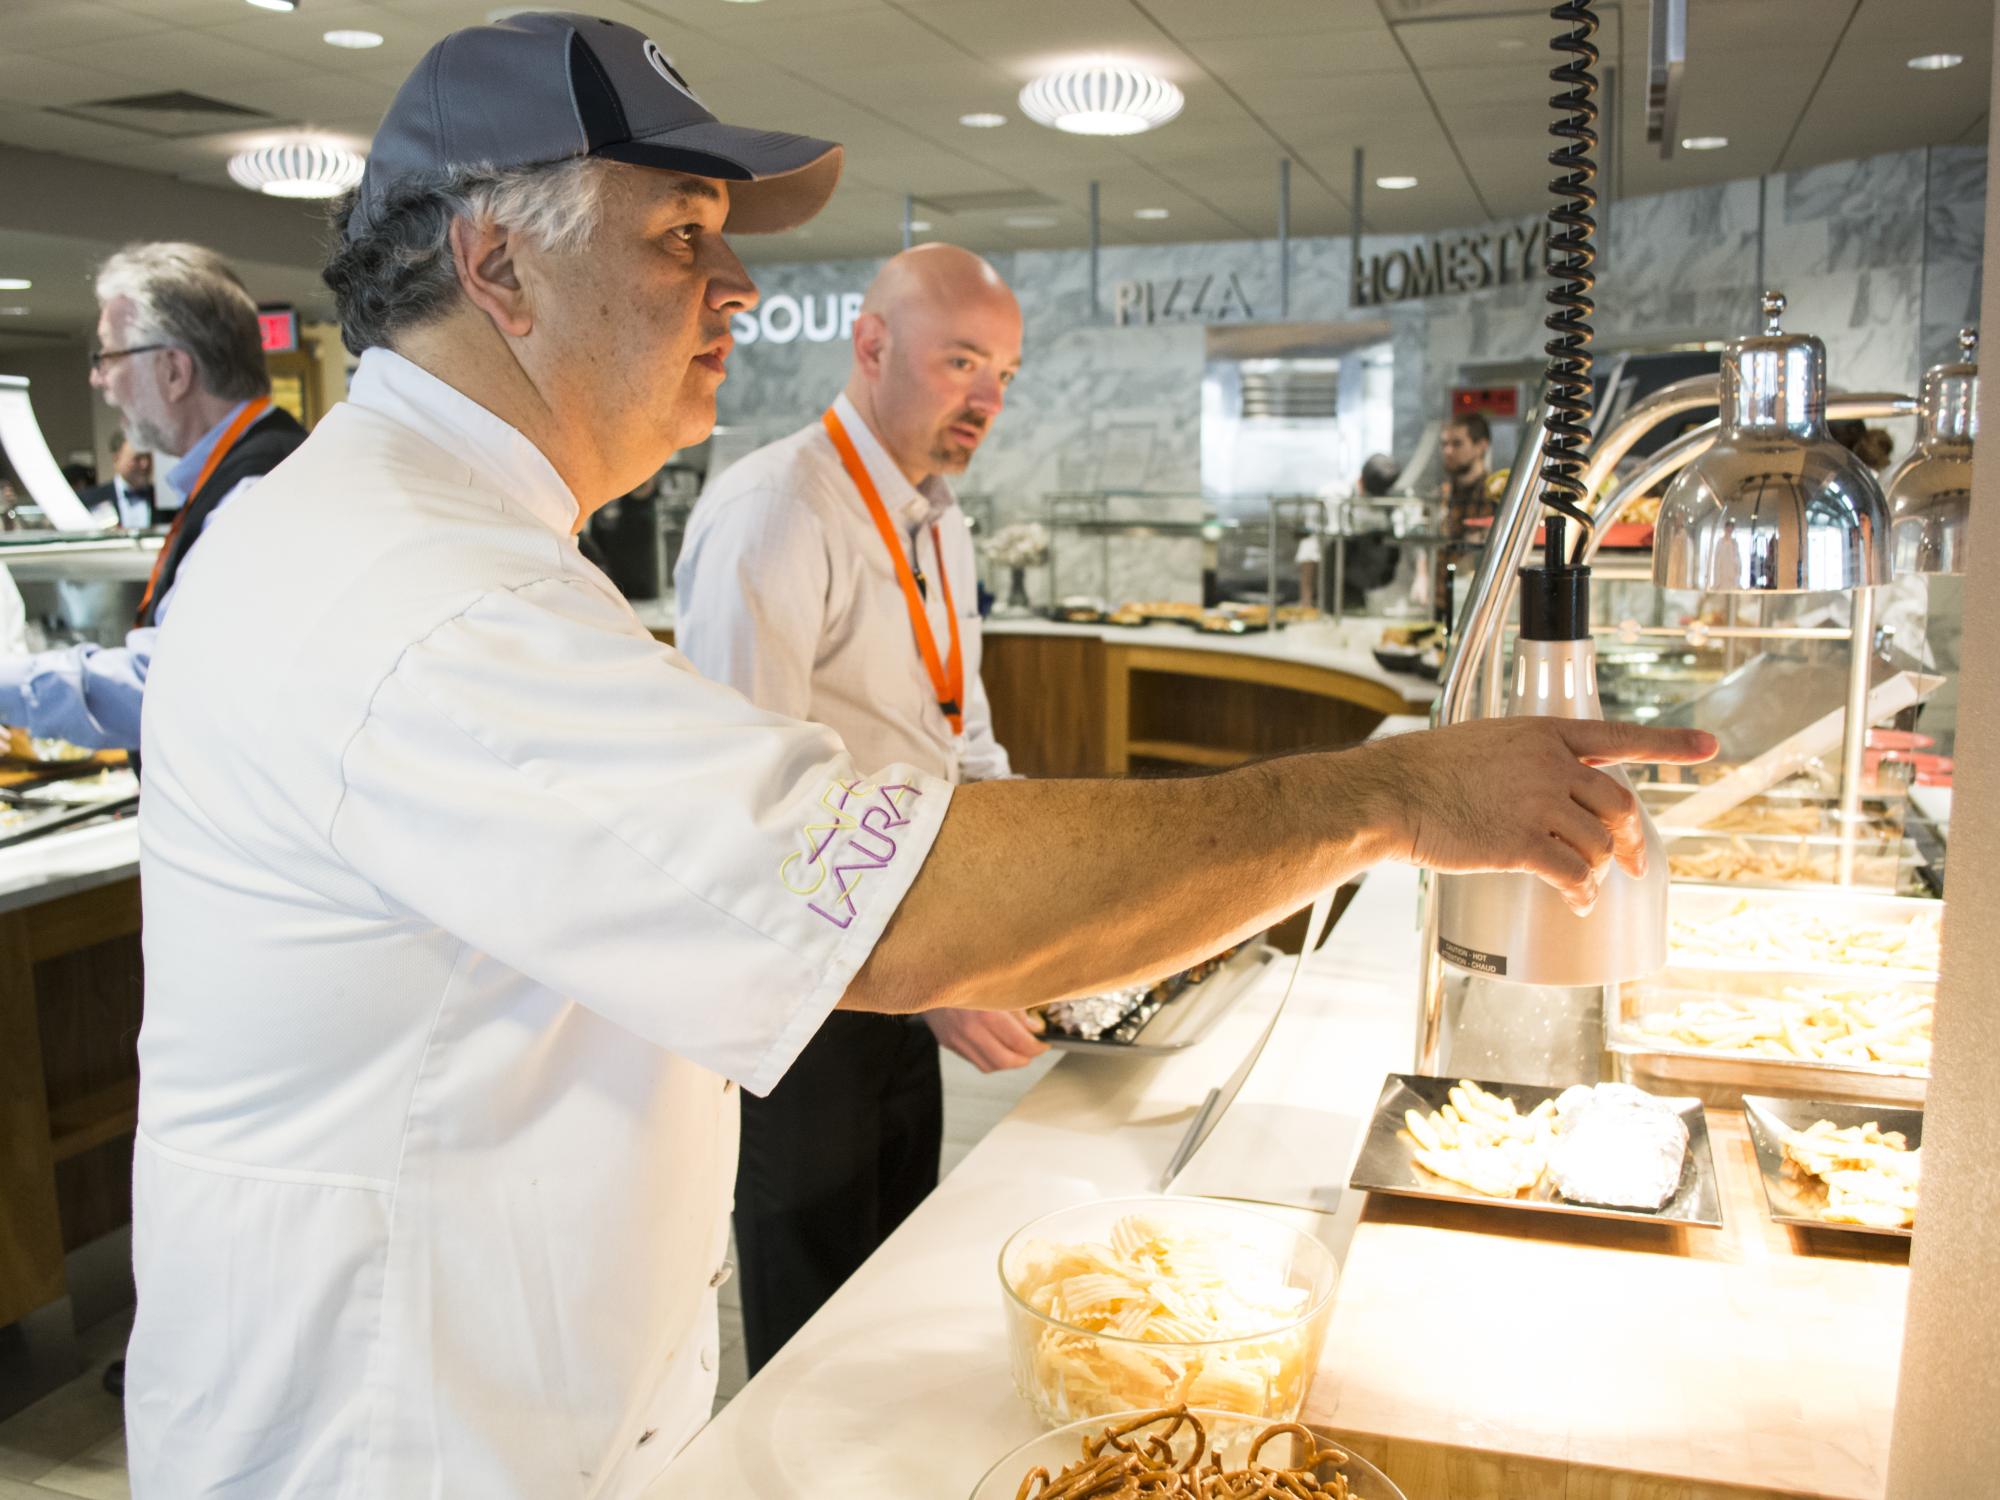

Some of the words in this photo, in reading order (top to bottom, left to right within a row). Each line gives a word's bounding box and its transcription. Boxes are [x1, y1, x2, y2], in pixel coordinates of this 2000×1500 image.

[730, 293, 864, 345] SOUP
[1114, 272, 1253, 326] PIZZA
[807, 777, 923, 929] LAURA
[1471, 961, 1497, 973] CHAUD
[1472, 952, 1488, 962] HOT
